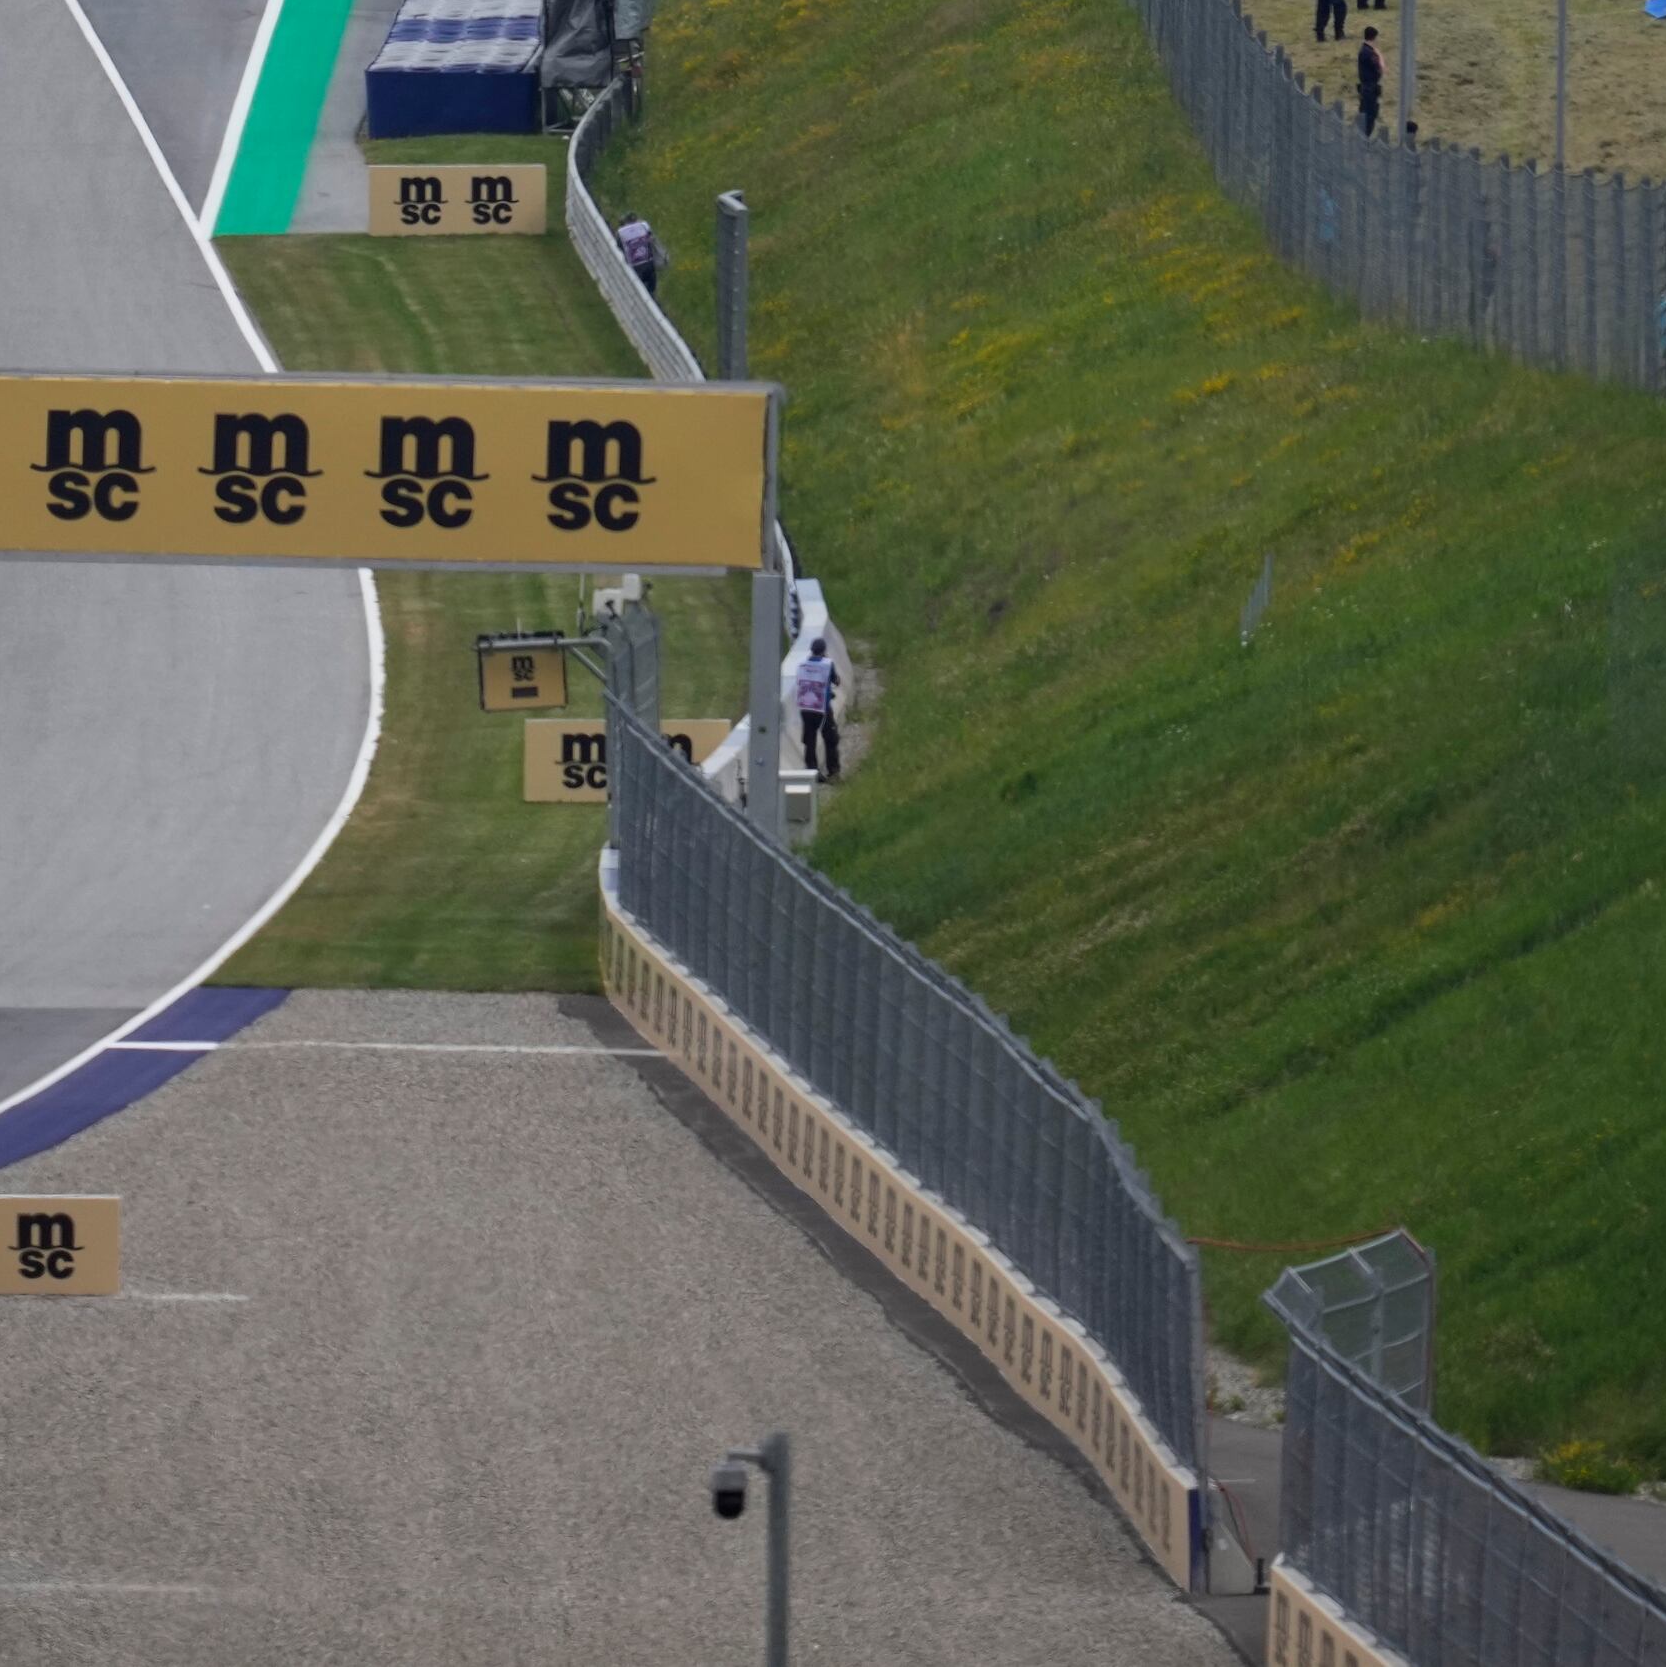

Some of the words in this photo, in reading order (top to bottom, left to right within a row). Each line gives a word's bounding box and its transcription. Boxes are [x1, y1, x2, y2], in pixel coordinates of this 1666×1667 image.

[401, 176, 442, 204] m
[472, 176, 513, 203] m
[401, 202, 442, 225] sc
[472, 201, 513, 224] sc
[45, 410, 141, 472] m
[213, 414, 308, 476] m
[379, 417, 475, 479] m
[546, 420, 641, 483] m
[46, 470, 139, 522] sc
[214, 474, 306, 525] sc
[380, 477, 473, 529] sc
[547, 481, 639, 532] sc
[512, 656, 534, 671] m
[563, 734, 606, 764] m
[563, 764, 607, 789] sc
[18, 1212, 74, 1249] m
[18, 1249, 74, 1280] sc
